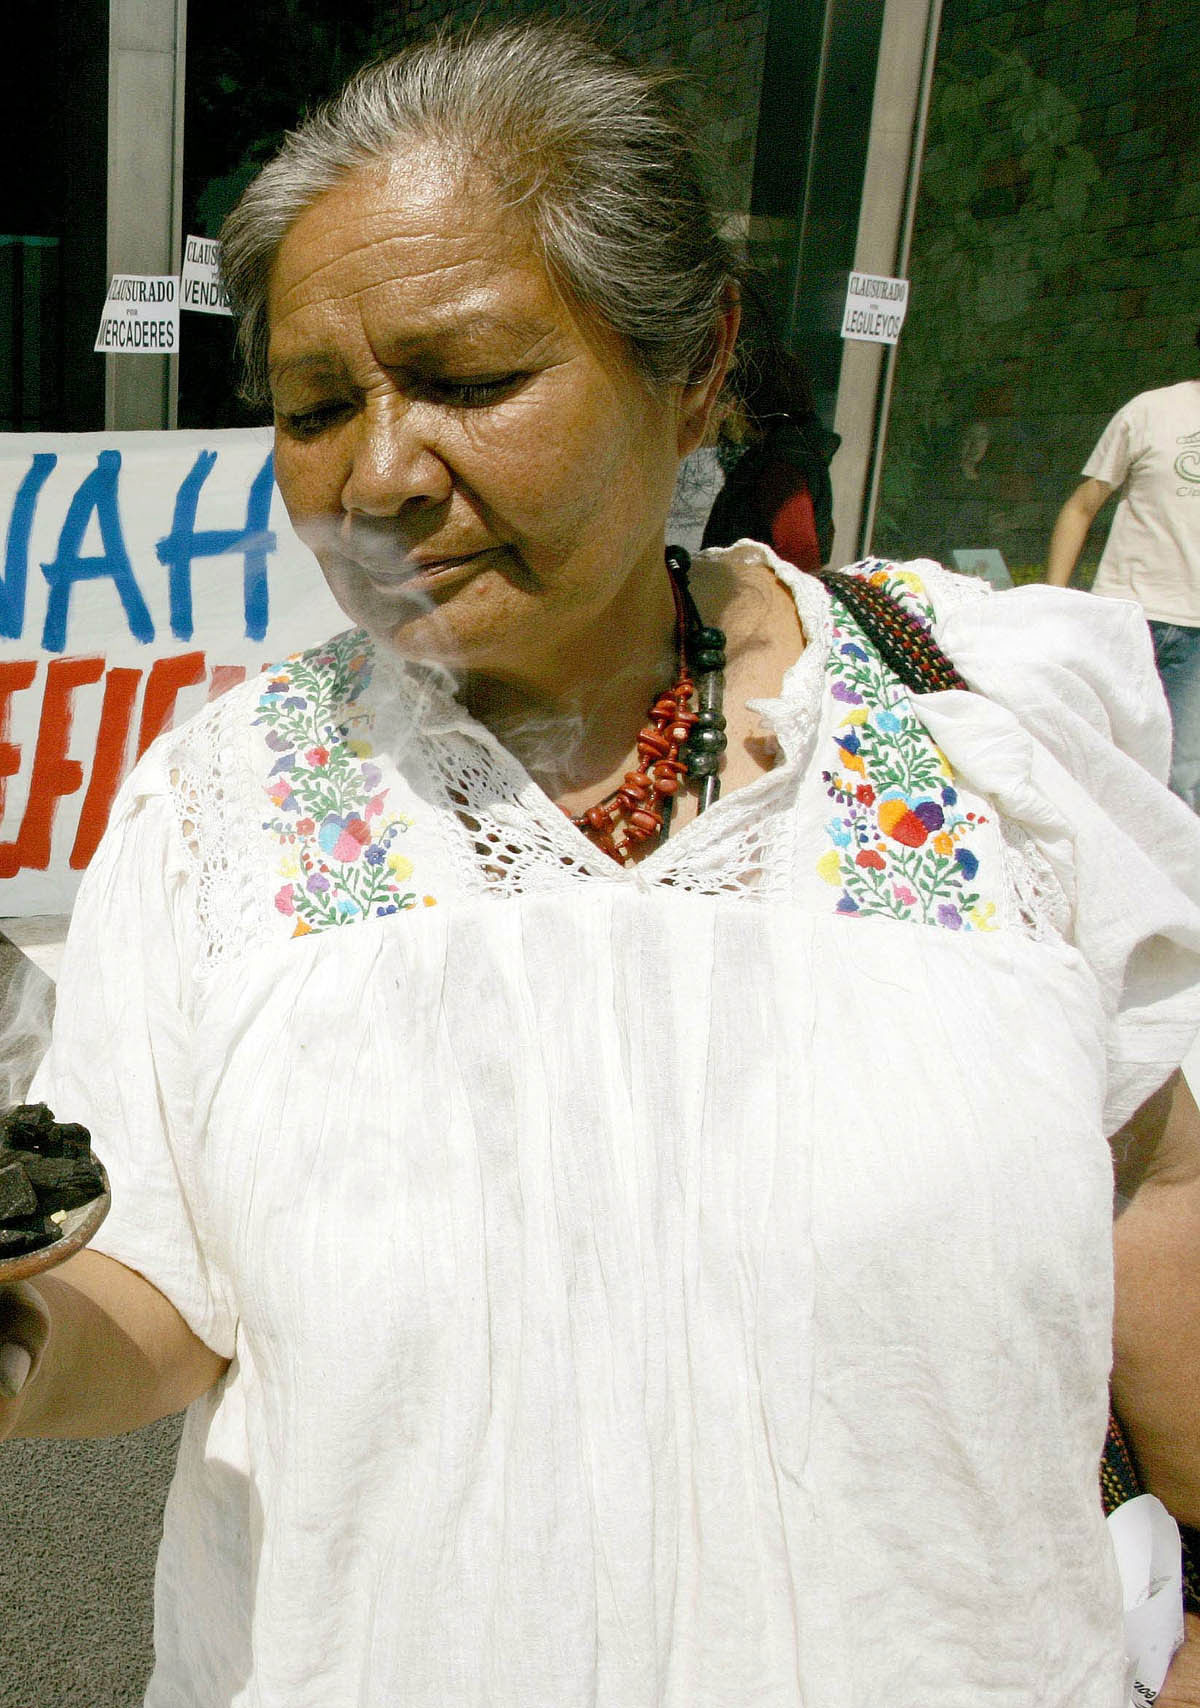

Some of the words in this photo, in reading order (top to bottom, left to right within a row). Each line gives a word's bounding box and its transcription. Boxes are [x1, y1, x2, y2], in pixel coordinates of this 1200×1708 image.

[849, 276, 906, 303] CLAUSURADO
[98, 319, 175, 348] MERCADERES
[845, 310, 901, 339] LEGULEYOS
